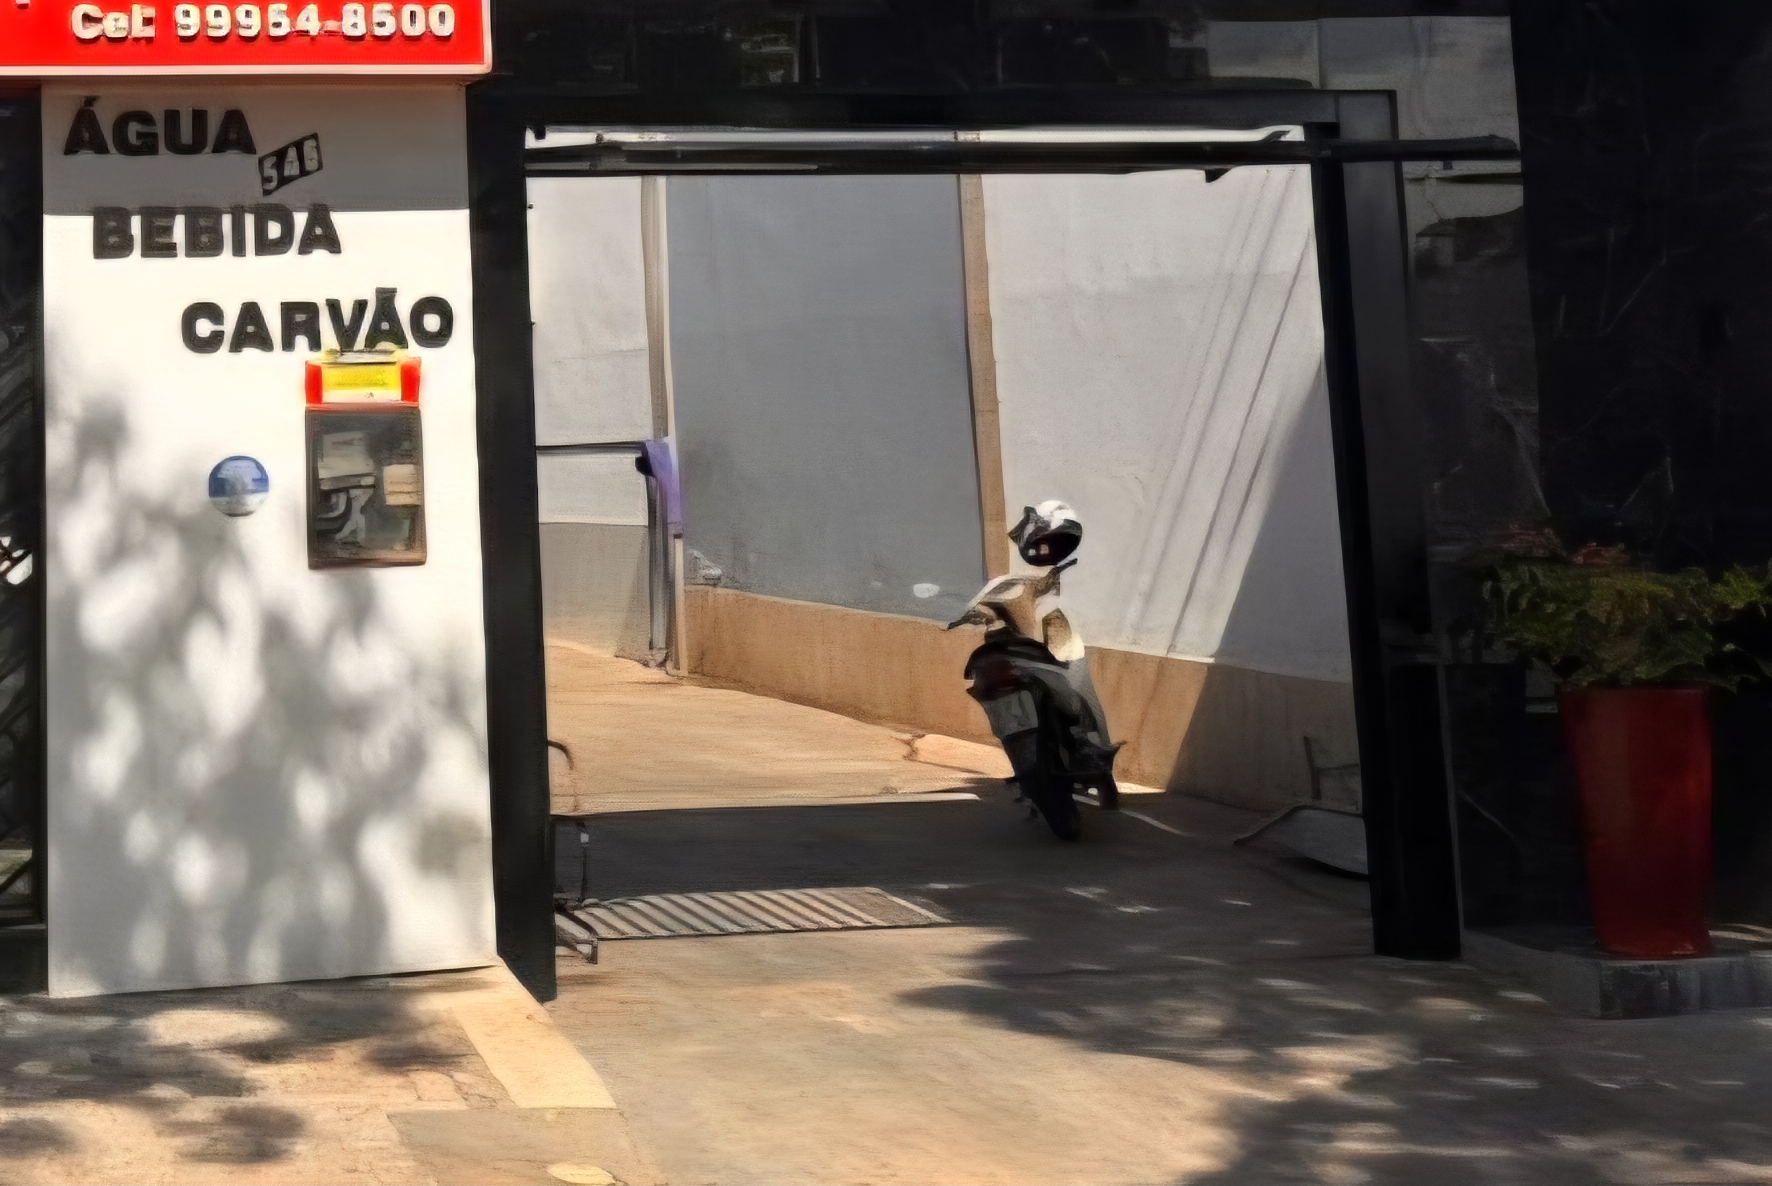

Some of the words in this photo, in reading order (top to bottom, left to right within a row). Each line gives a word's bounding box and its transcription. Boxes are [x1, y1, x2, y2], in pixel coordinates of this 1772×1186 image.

[175, 3, 456, 41] 99954-8500
[63, 95, 257, 156] ÁGUA
[92, 203, 342, 260] BEBIDA
[181, 287, 454, 354] CARVÃO
